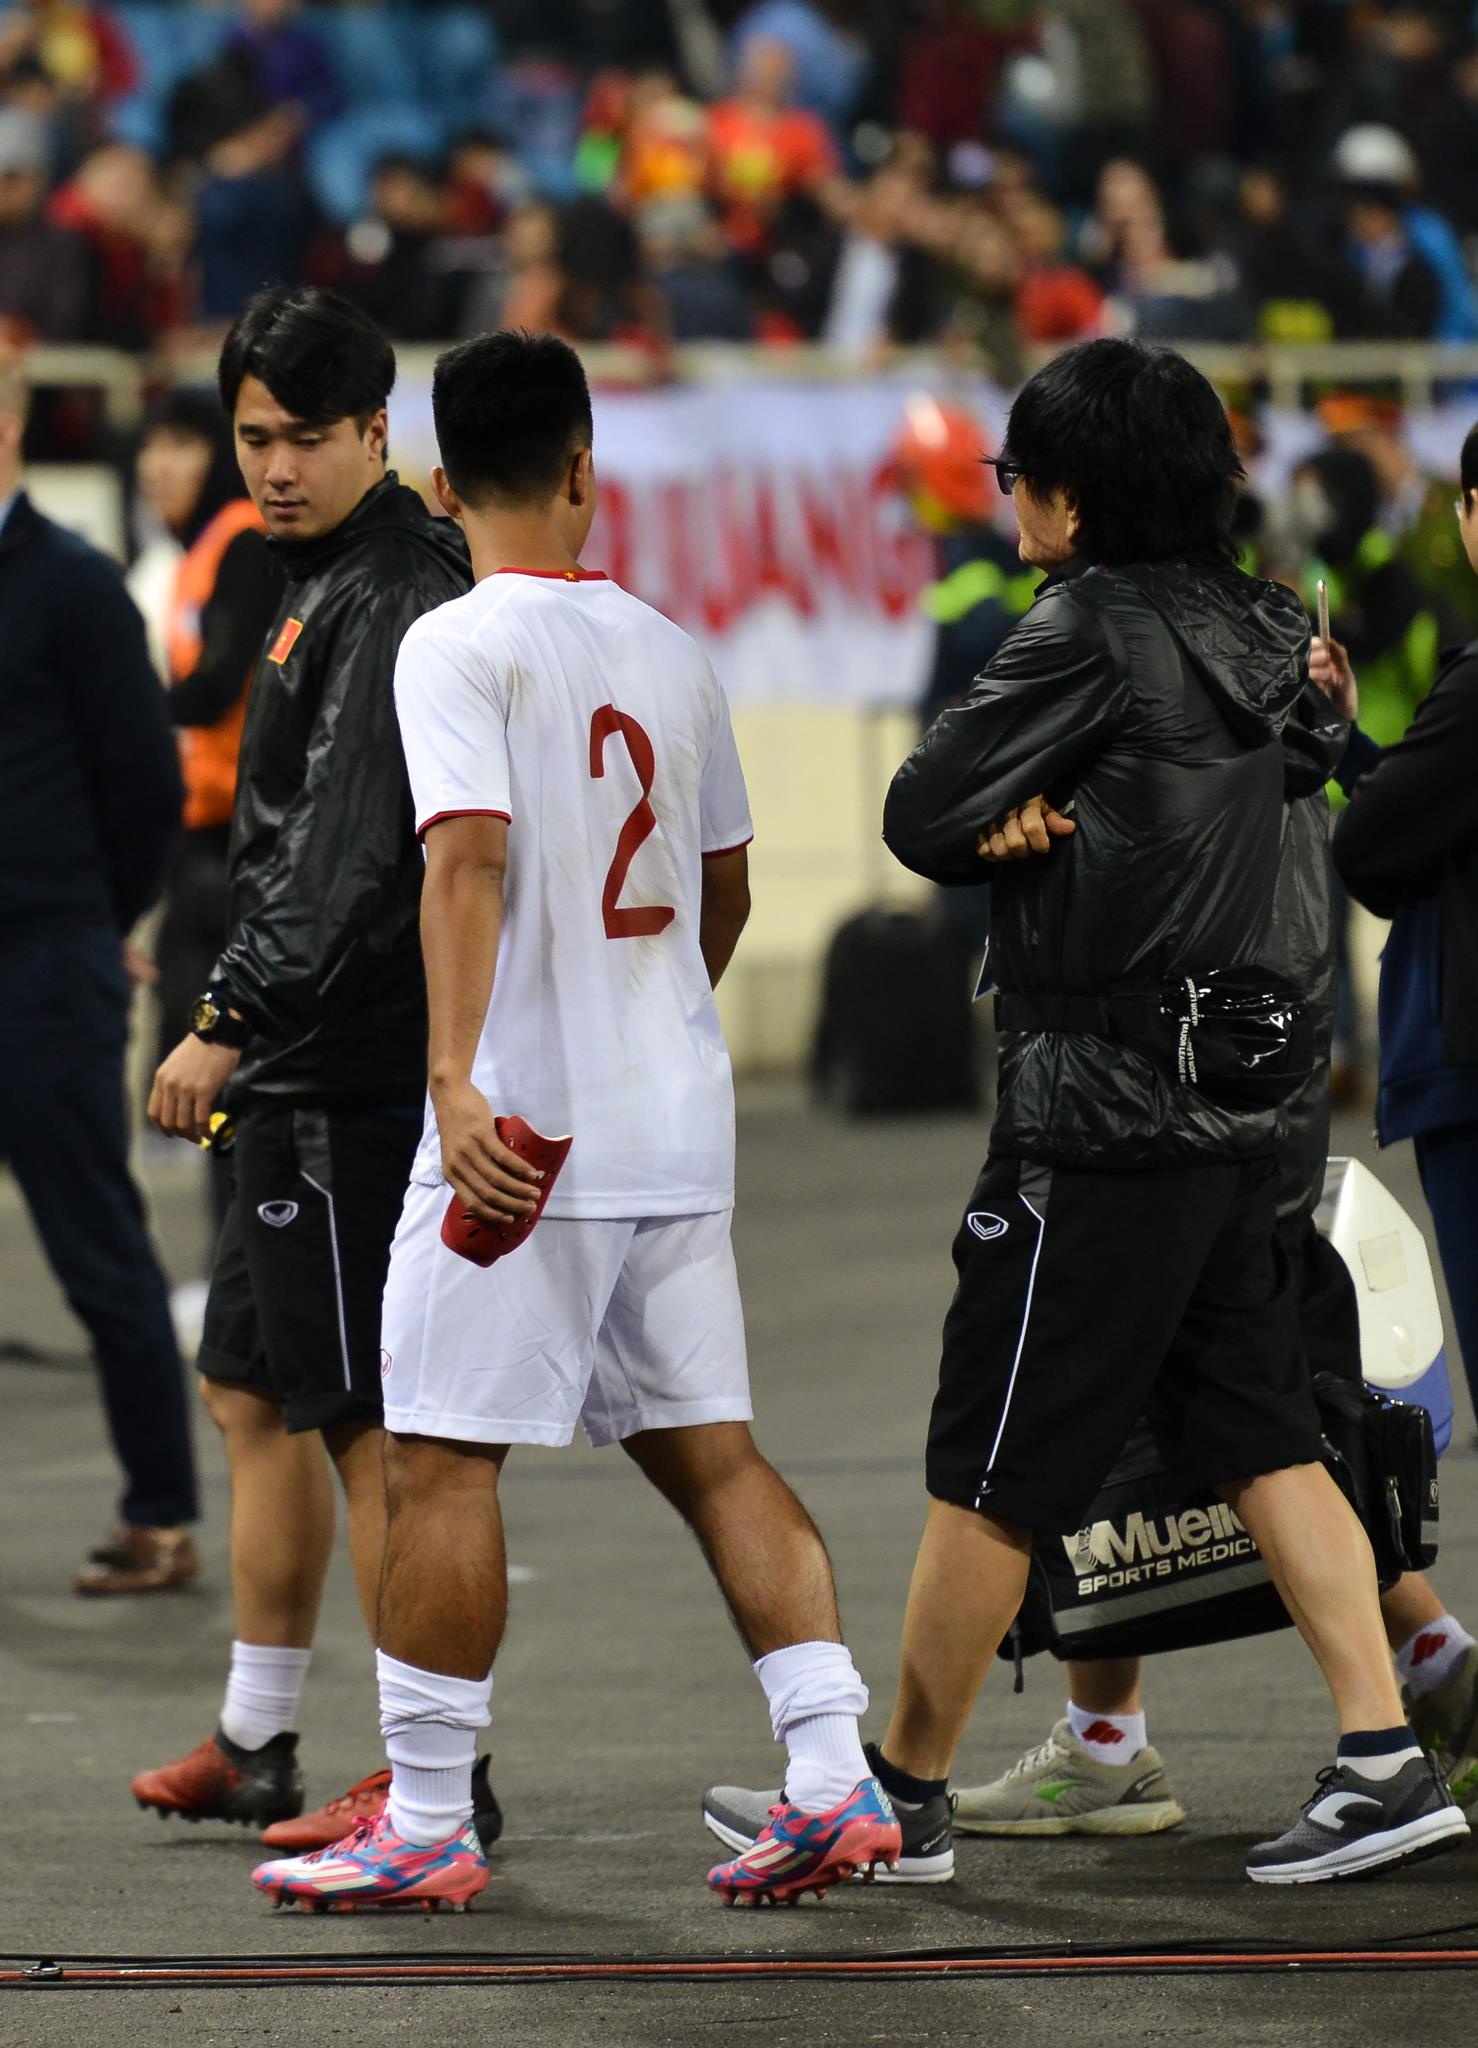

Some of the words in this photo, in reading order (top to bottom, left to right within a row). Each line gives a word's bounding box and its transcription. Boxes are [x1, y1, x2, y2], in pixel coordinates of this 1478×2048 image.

[589, 703, 675, 939] 2
[1179, 1023, 1189, 1047] MAJOR
[1178, 1047, 1187, 1074] LEAGUE
[1078, 1559, 1172, 1596] SPORTS
